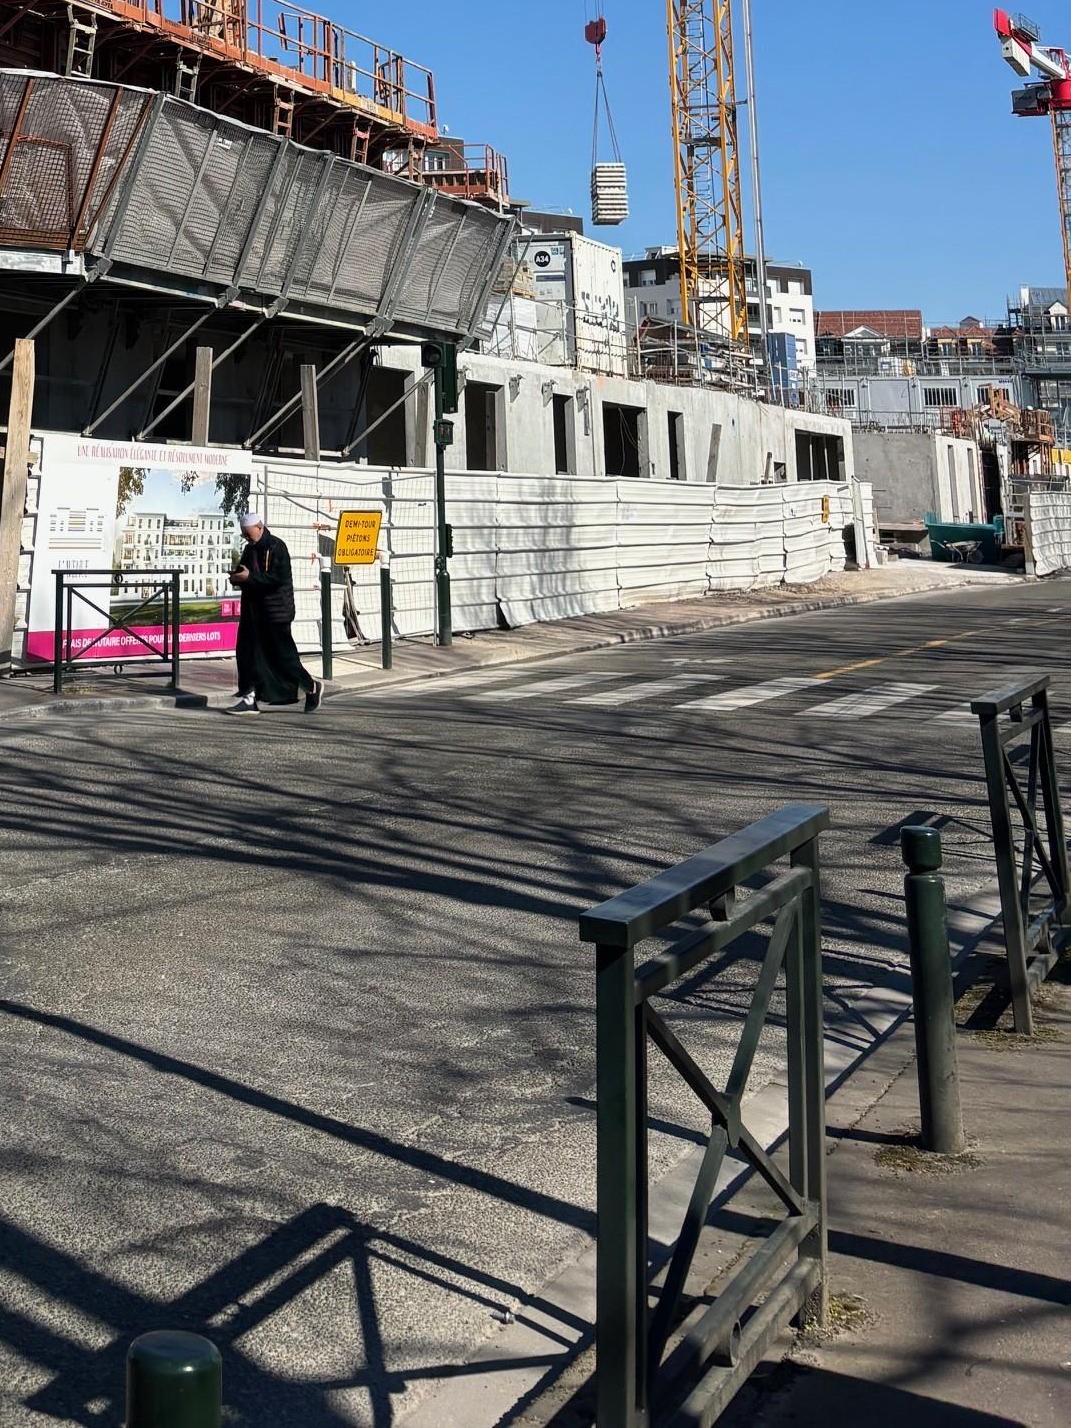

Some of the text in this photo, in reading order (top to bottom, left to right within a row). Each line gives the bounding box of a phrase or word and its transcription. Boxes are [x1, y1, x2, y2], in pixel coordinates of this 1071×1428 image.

[535, 254, 549, 263] A34
[344, 520, 376, 528] DEMI-TOUR
[346, 533, 371, 542] PIÉTONS
[337, 548, 374, 557] OBLIGATOIRE
[62, 638, 82, 649] FAIS
[207, 631, 221, 641] LOTS
